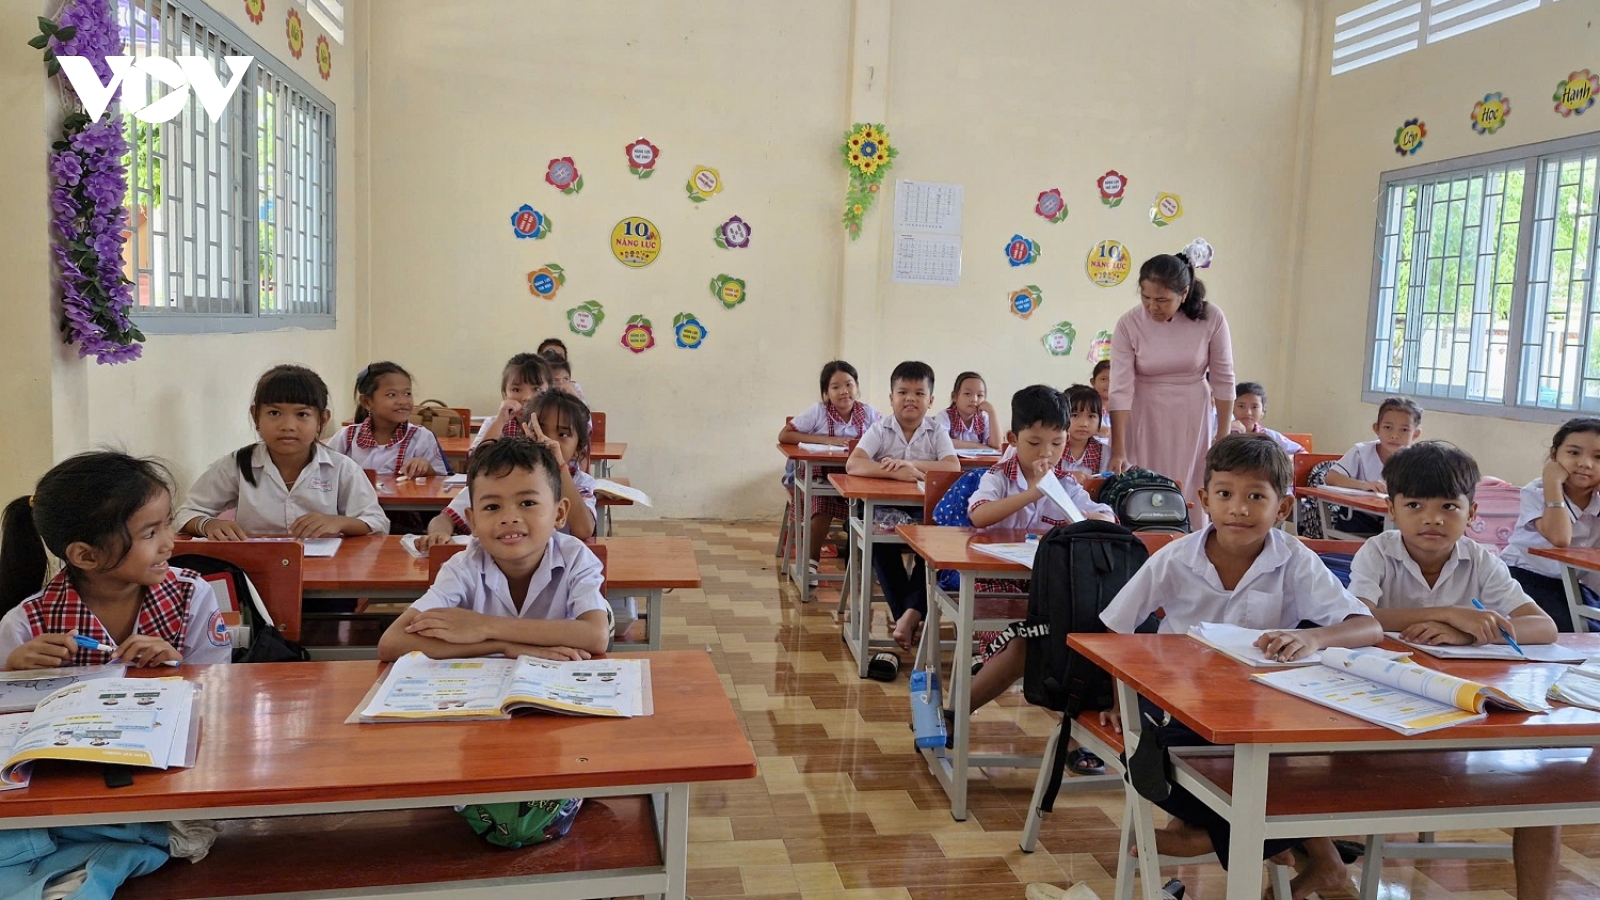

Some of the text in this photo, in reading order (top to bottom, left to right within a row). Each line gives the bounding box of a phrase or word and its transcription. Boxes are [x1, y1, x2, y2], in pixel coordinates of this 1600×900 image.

[1562, 82, 1591, 105] Hạnh
[1481, 107, 1499, 123] Học
[624, 221, 648, 237] 10
[1098, 244, 1120, 259] 10
